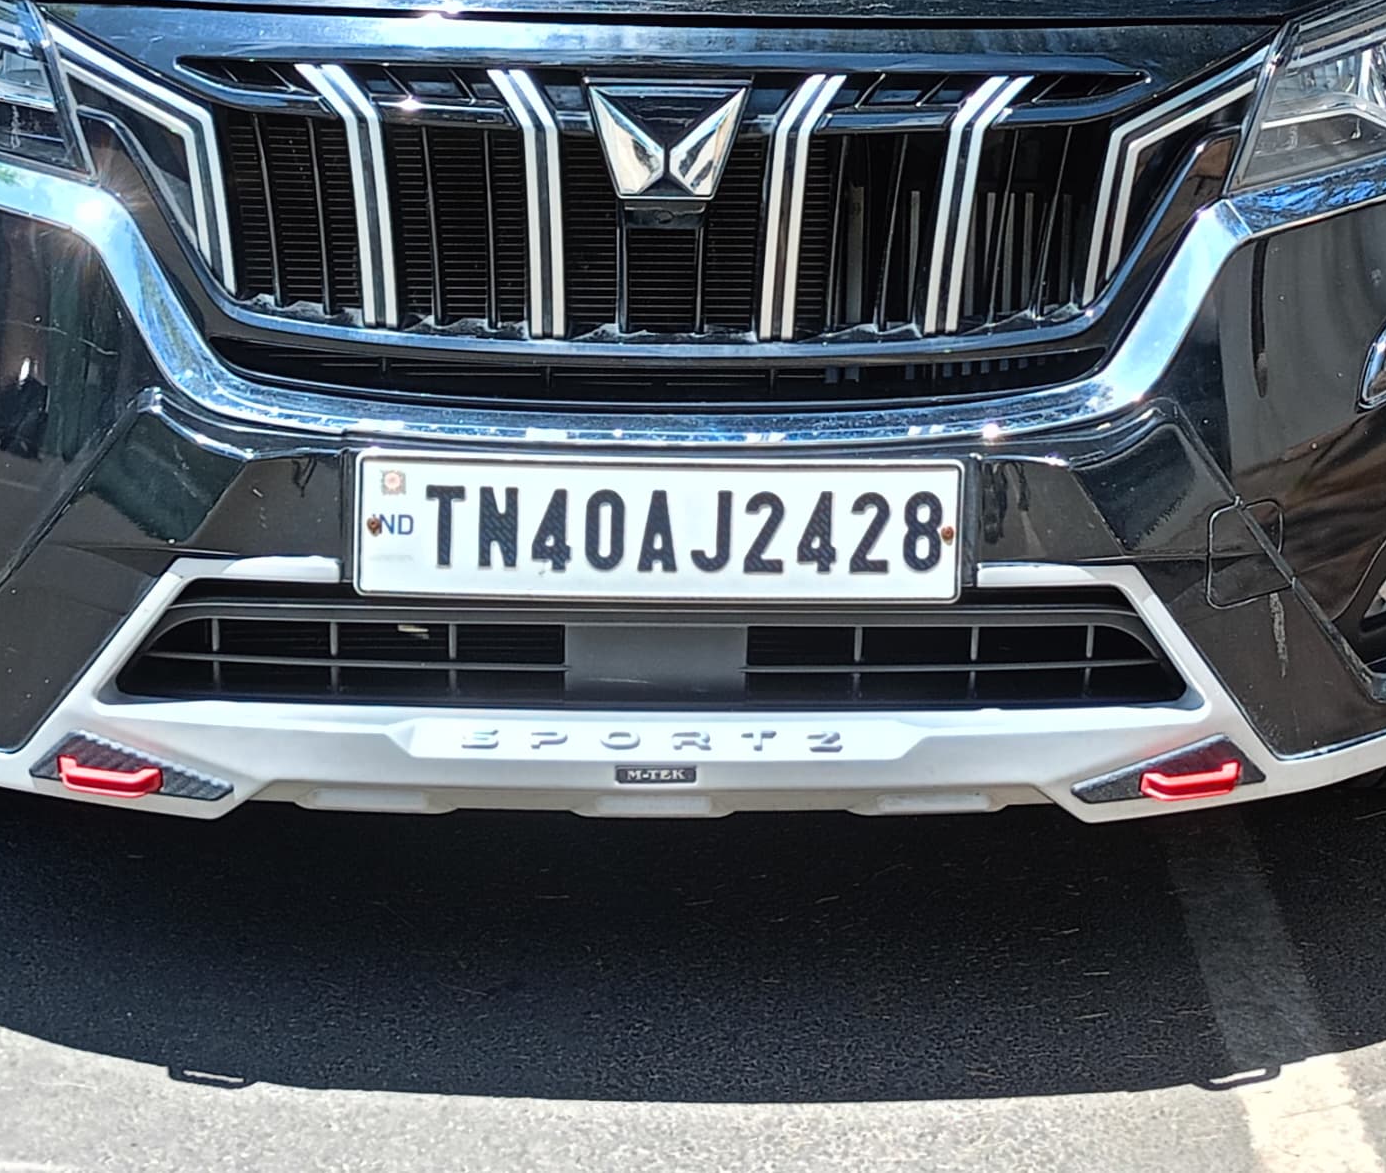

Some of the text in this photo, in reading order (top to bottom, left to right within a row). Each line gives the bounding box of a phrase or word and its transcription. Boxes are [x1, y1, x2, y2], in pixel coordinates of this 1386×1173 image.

[370, 514, 414, 535] ND
[425, 484, 943, 574] TN40AJ2428
[625, 769, 687, 781] M-TEK
